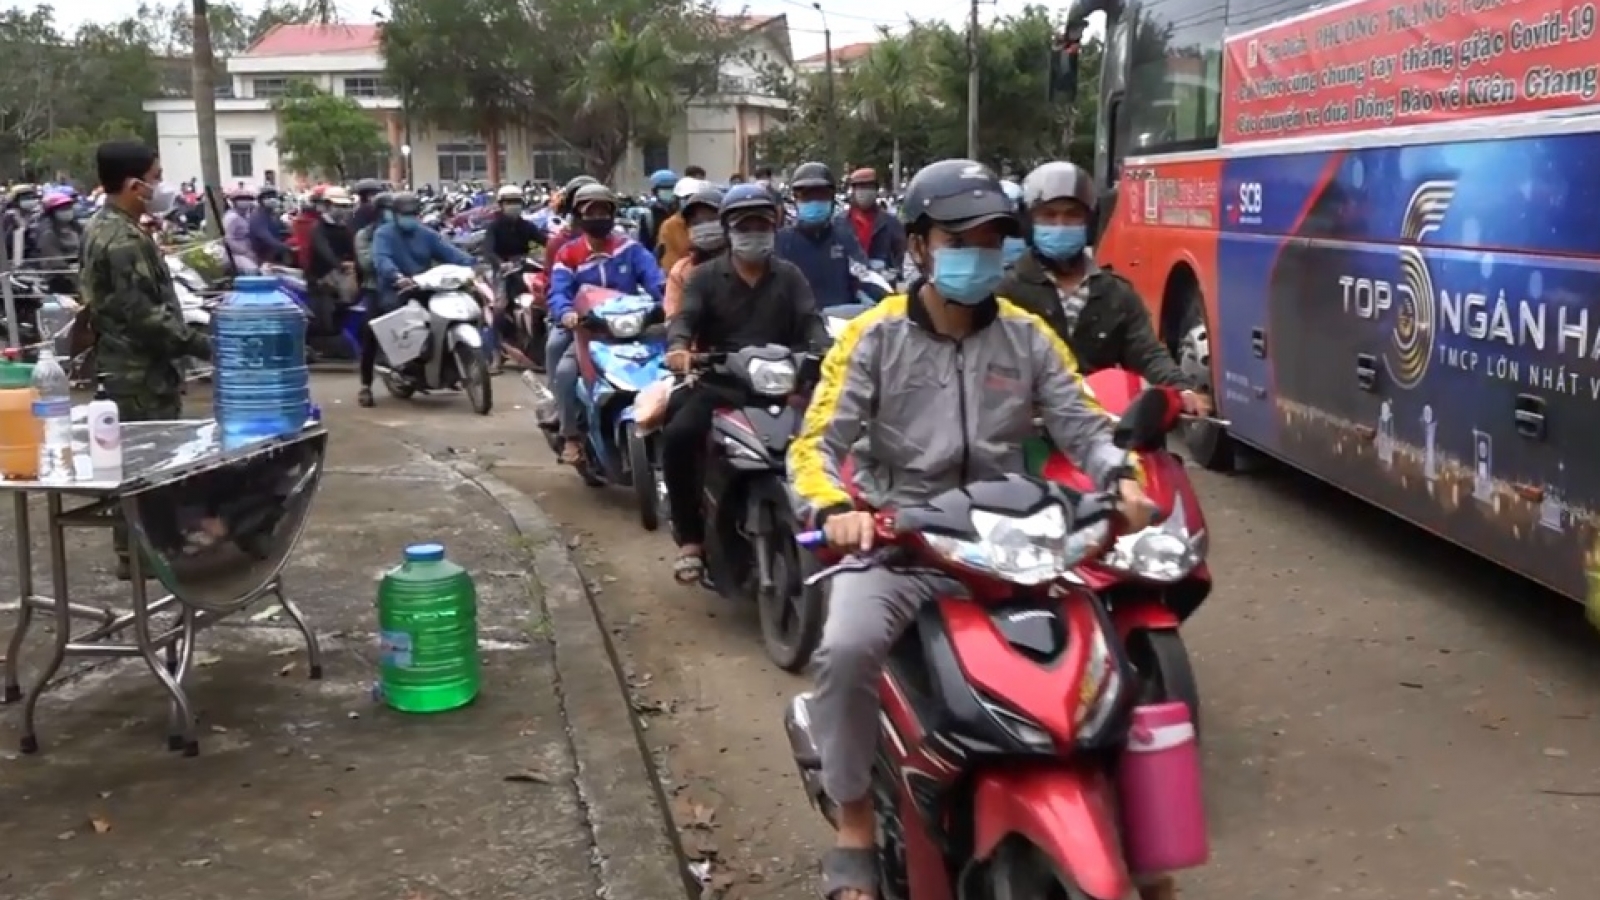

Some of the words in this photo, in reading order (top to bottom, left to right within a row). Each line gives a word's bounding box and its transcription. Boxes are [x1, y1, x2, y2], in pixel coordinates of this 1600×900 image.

[1322, 62, 1365, 88] chung
[1371, 56, 1397, 82] tay
[1510, 4, 1595, 52] Covid-19
[1466, 74, 1515, 107] Kiên
[1525, 64, 1599, 99] Giang
[1240, 183, 1262, 213] SCB
[1339, 275, 1393, 321] TOP
[1439, 344, 1478, 371] TMCP
